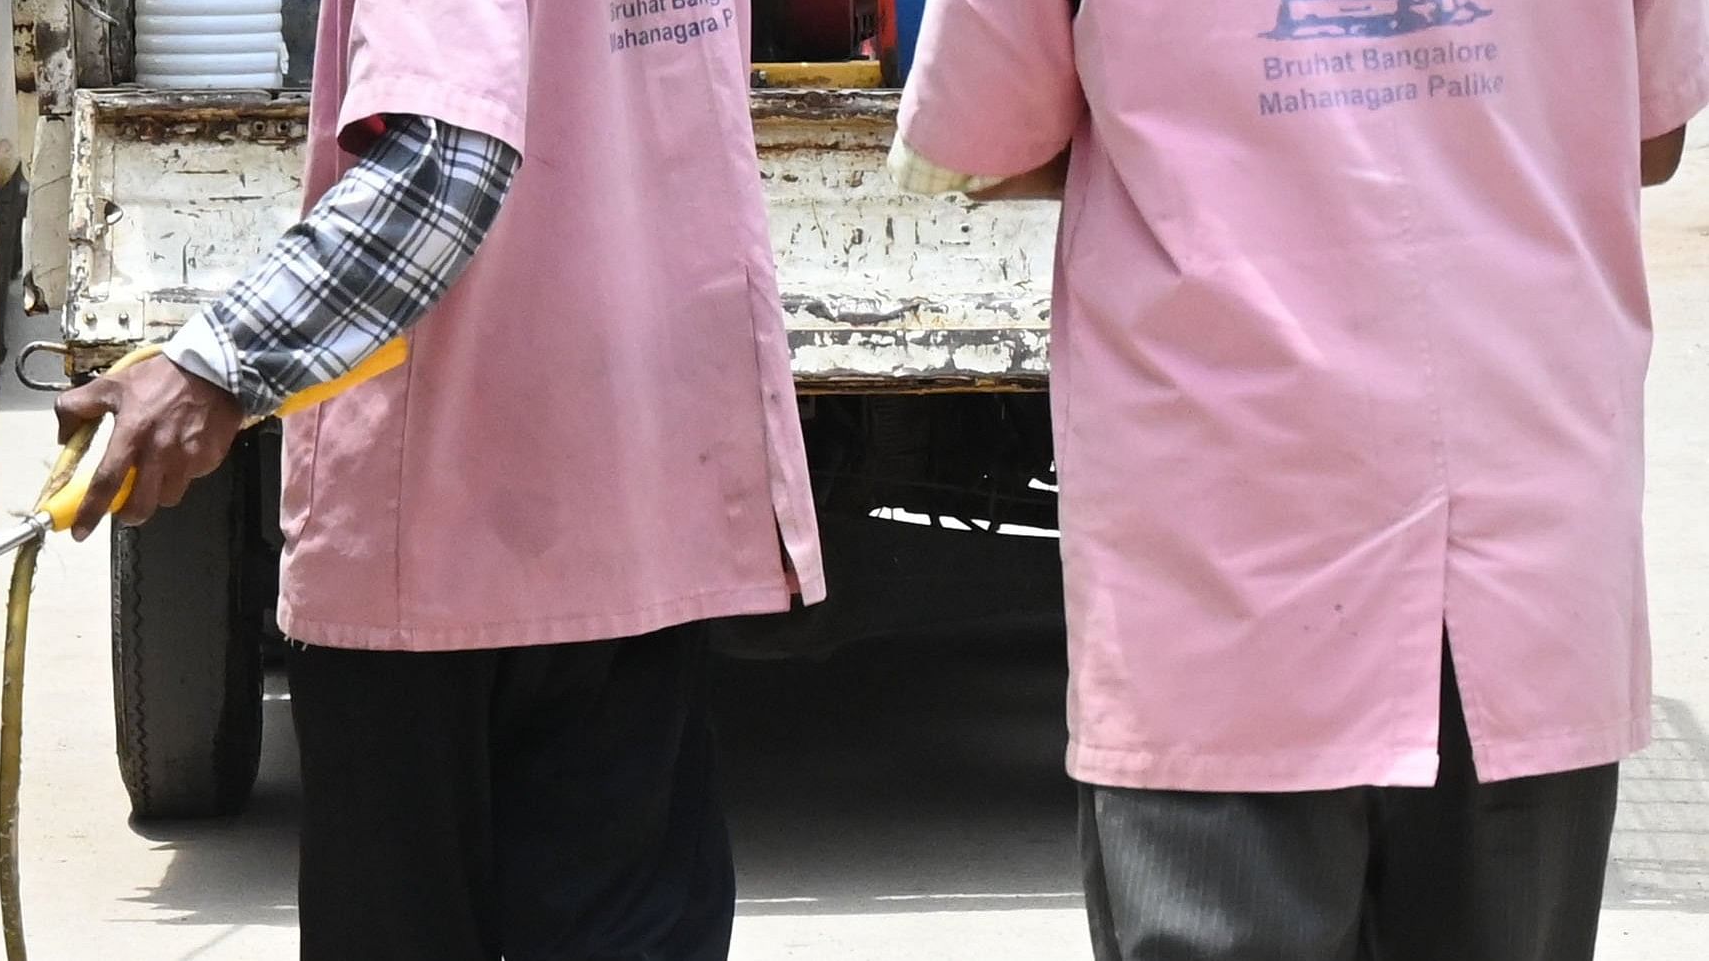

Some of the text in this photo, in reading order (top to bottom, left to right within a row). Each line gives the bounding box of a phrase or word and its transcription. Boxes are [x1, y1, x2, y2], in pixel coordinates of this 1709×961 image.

[1263, 40, 1499, 80] Bruhat Bangalore
[1259, 74, 1504, 116] Mahanagara Palike
